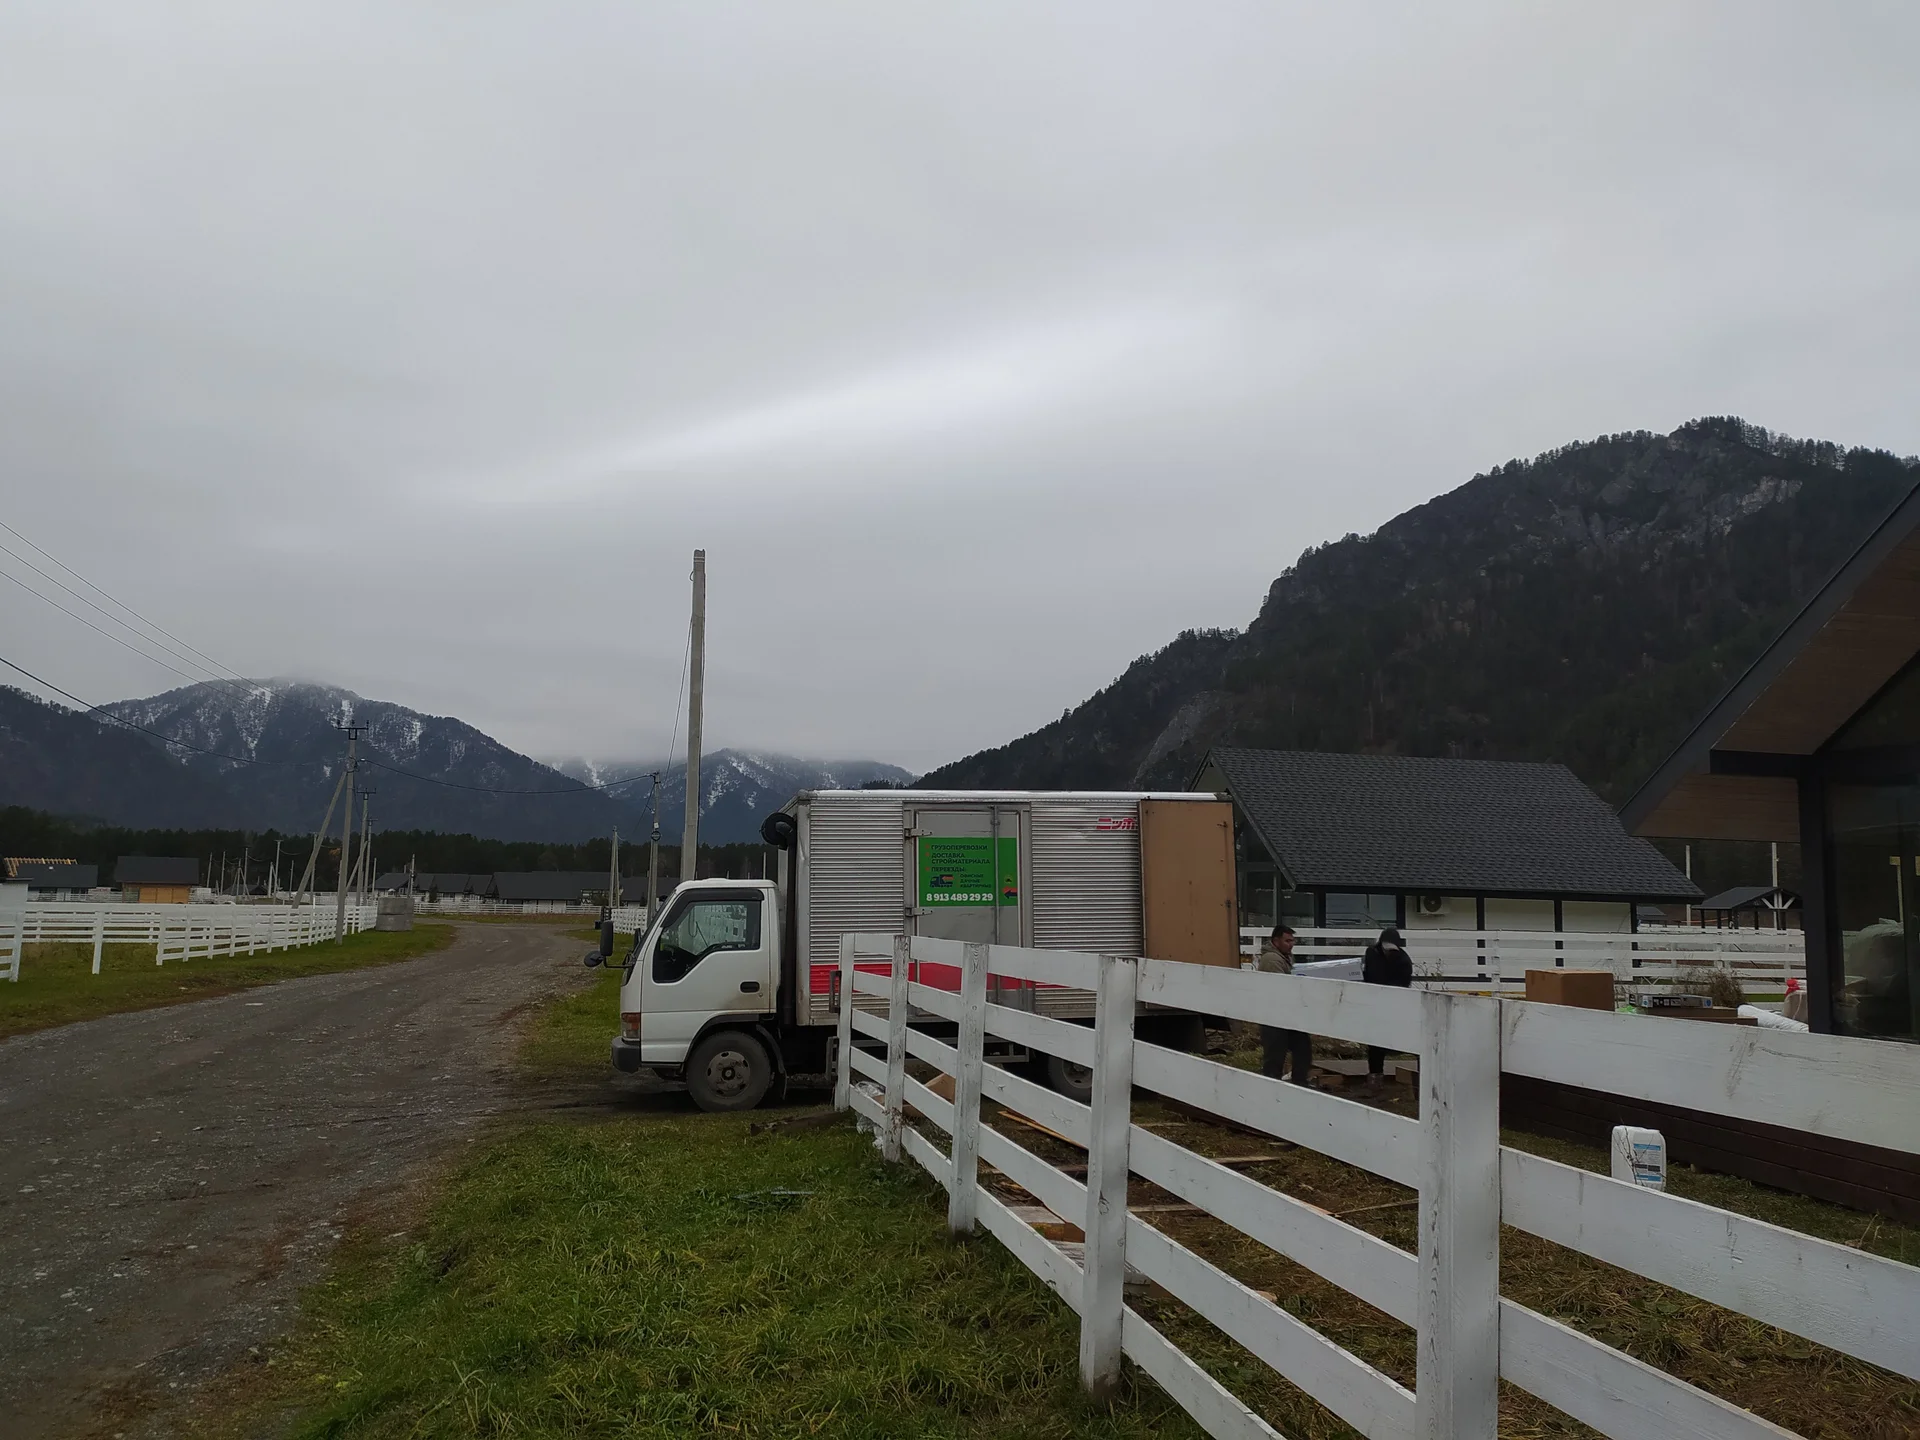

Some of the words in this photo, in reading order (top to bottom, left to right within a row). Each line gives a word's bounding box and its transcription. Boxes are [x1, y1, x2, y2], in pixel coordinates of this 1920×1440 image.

[926, 893, 933, 902] 8
[933, 893, 950, 902] 913
[950, 893, 969, 902] 489
[969, 893, 981, 902] 29
[981, 893, 994, 902] 29
